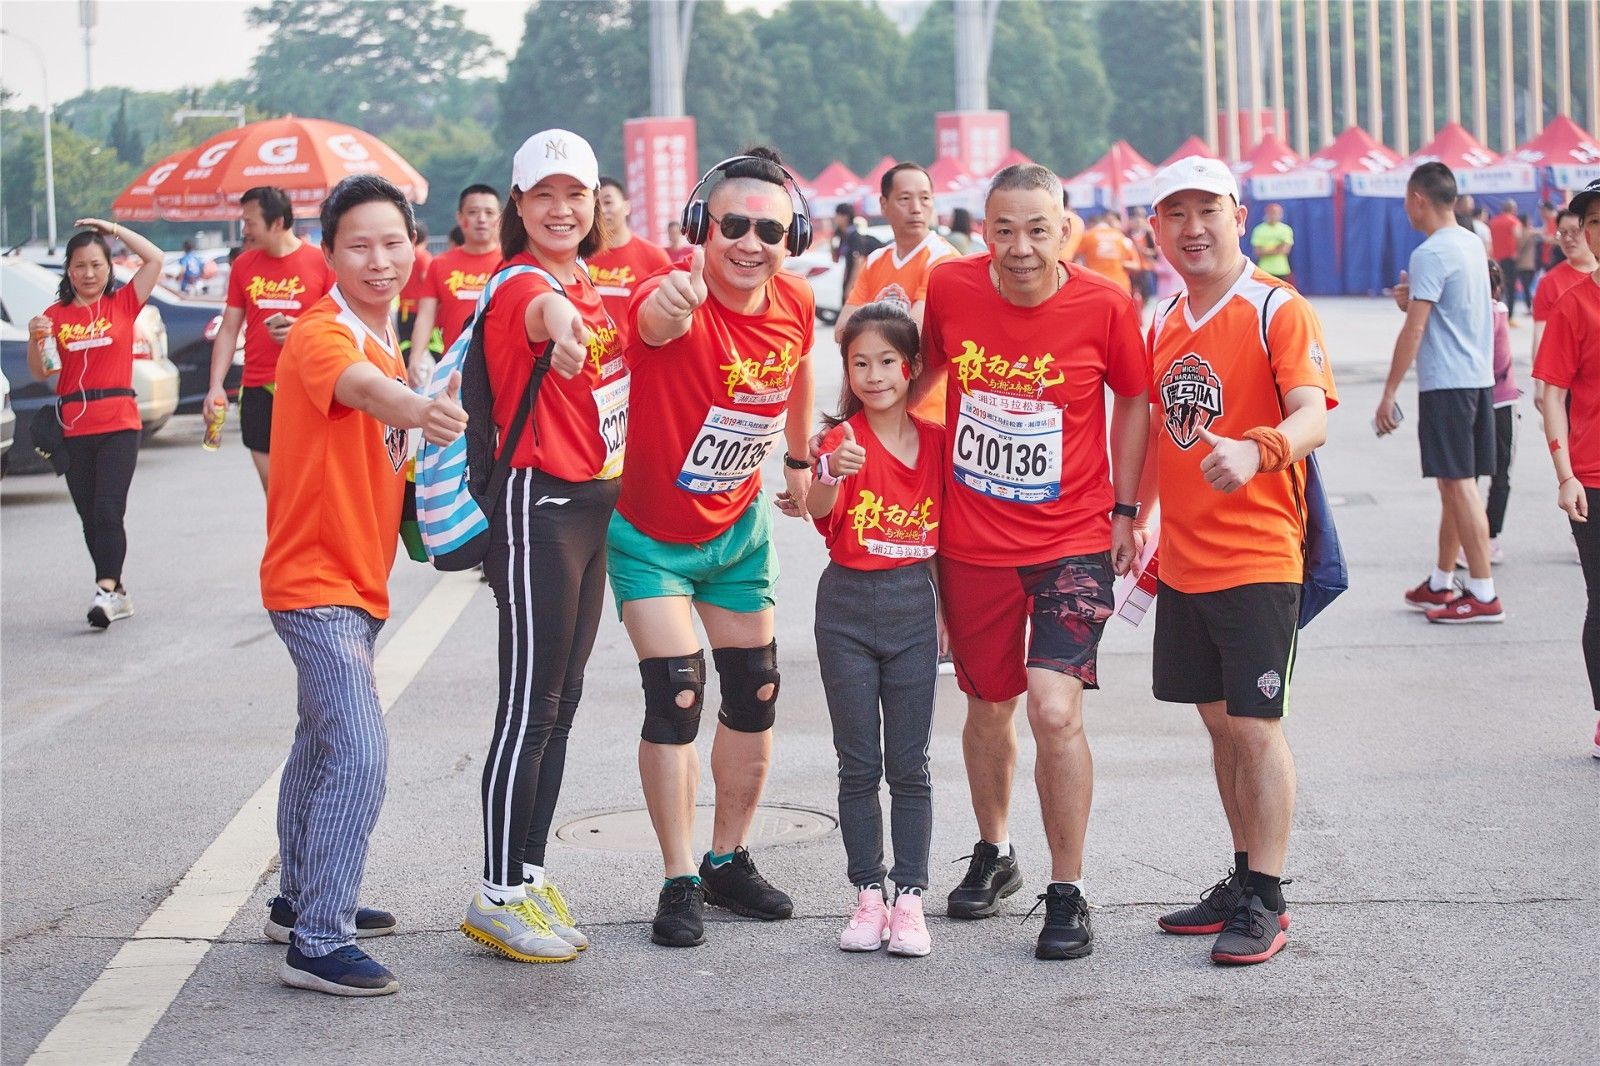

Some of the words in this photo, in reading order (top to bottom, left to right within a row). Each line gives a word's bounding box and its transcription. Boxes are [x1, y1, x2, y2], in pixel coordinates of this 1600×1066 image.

[1174, 373, 1205, 382] MARATHON
[978, 394, 1045, 411] 湘江马拉松赛
[692, 434, 772, 471] C10135
[957, 424, 1047, 477] C10136
[872, 543, 930, 557] 湘江马拉松赛
